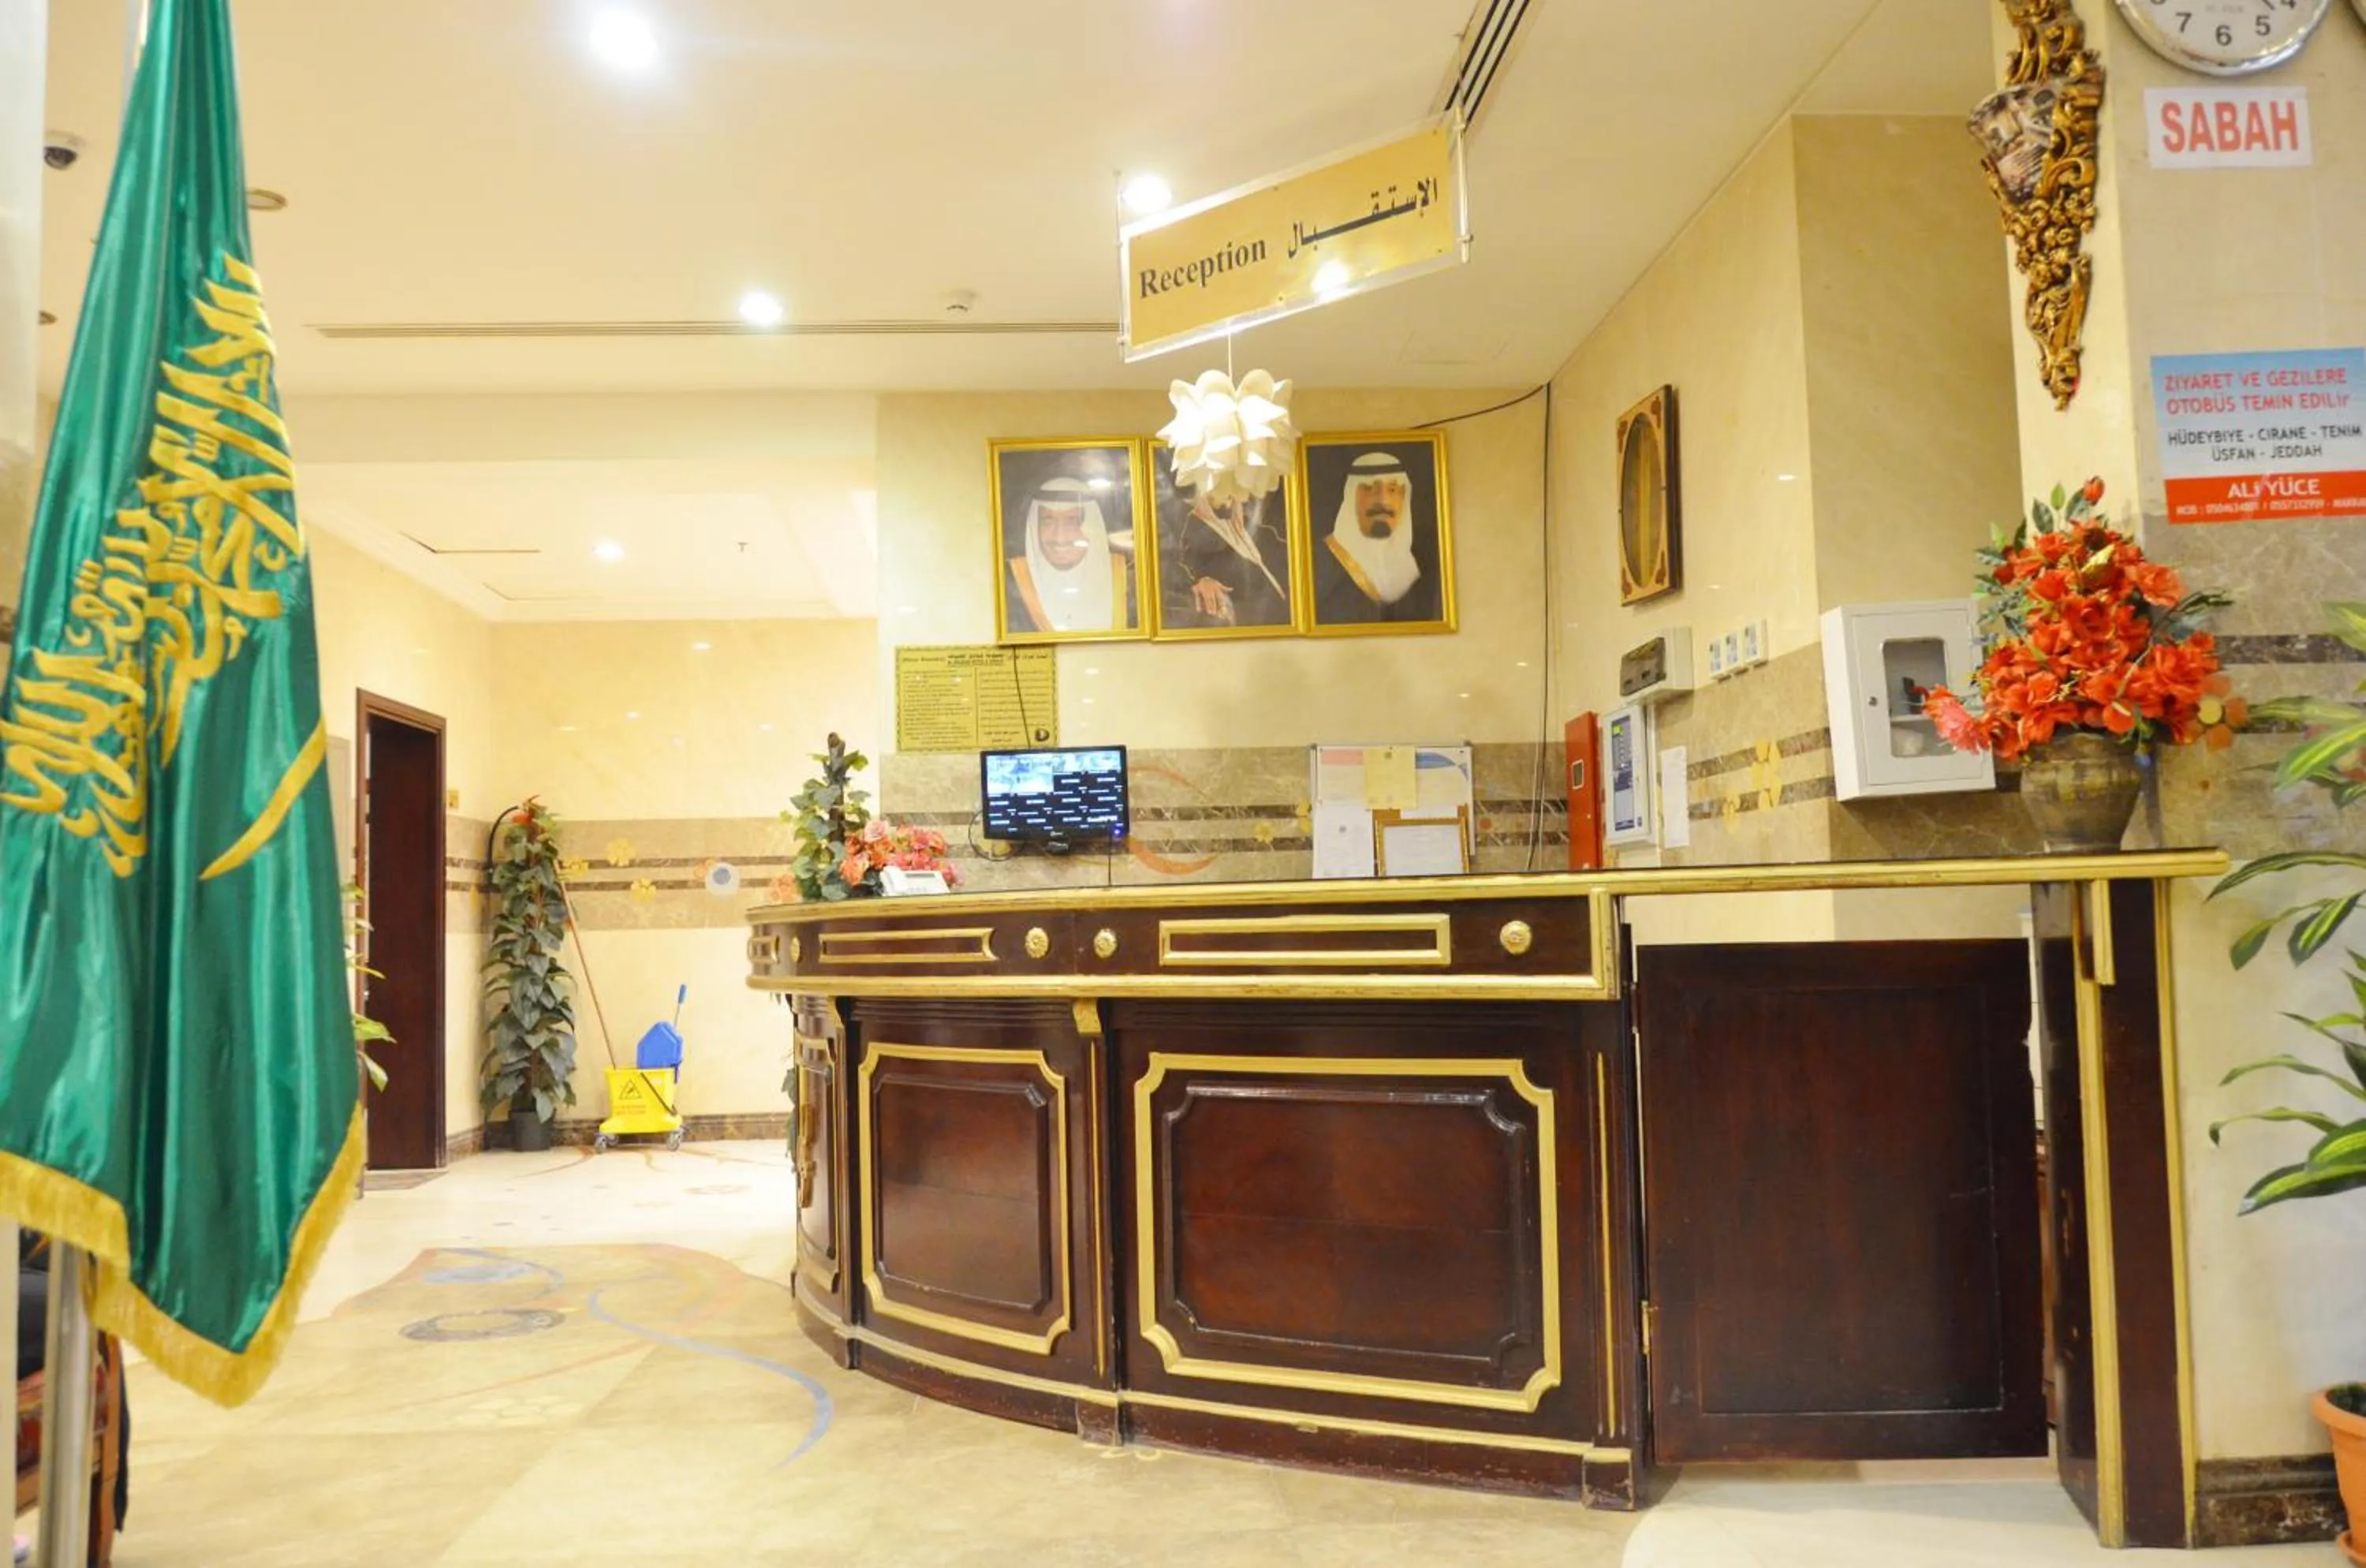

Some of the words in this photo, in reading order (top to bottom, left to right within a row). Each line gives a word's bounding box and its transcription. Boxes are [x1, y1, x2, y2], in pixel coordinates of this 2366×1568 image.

[2175, 12, 2192, 33] 7
[2255, 15, 2271, 36] 5
[2215, 24, 2233, 47] 6
[2160, 100, 2299, 153] SABAH
[1139, 237, 1267, 299] Reception
[2241, 371, 2261, 387] VE
[2264, 476, 2321, 496] YÜCE
